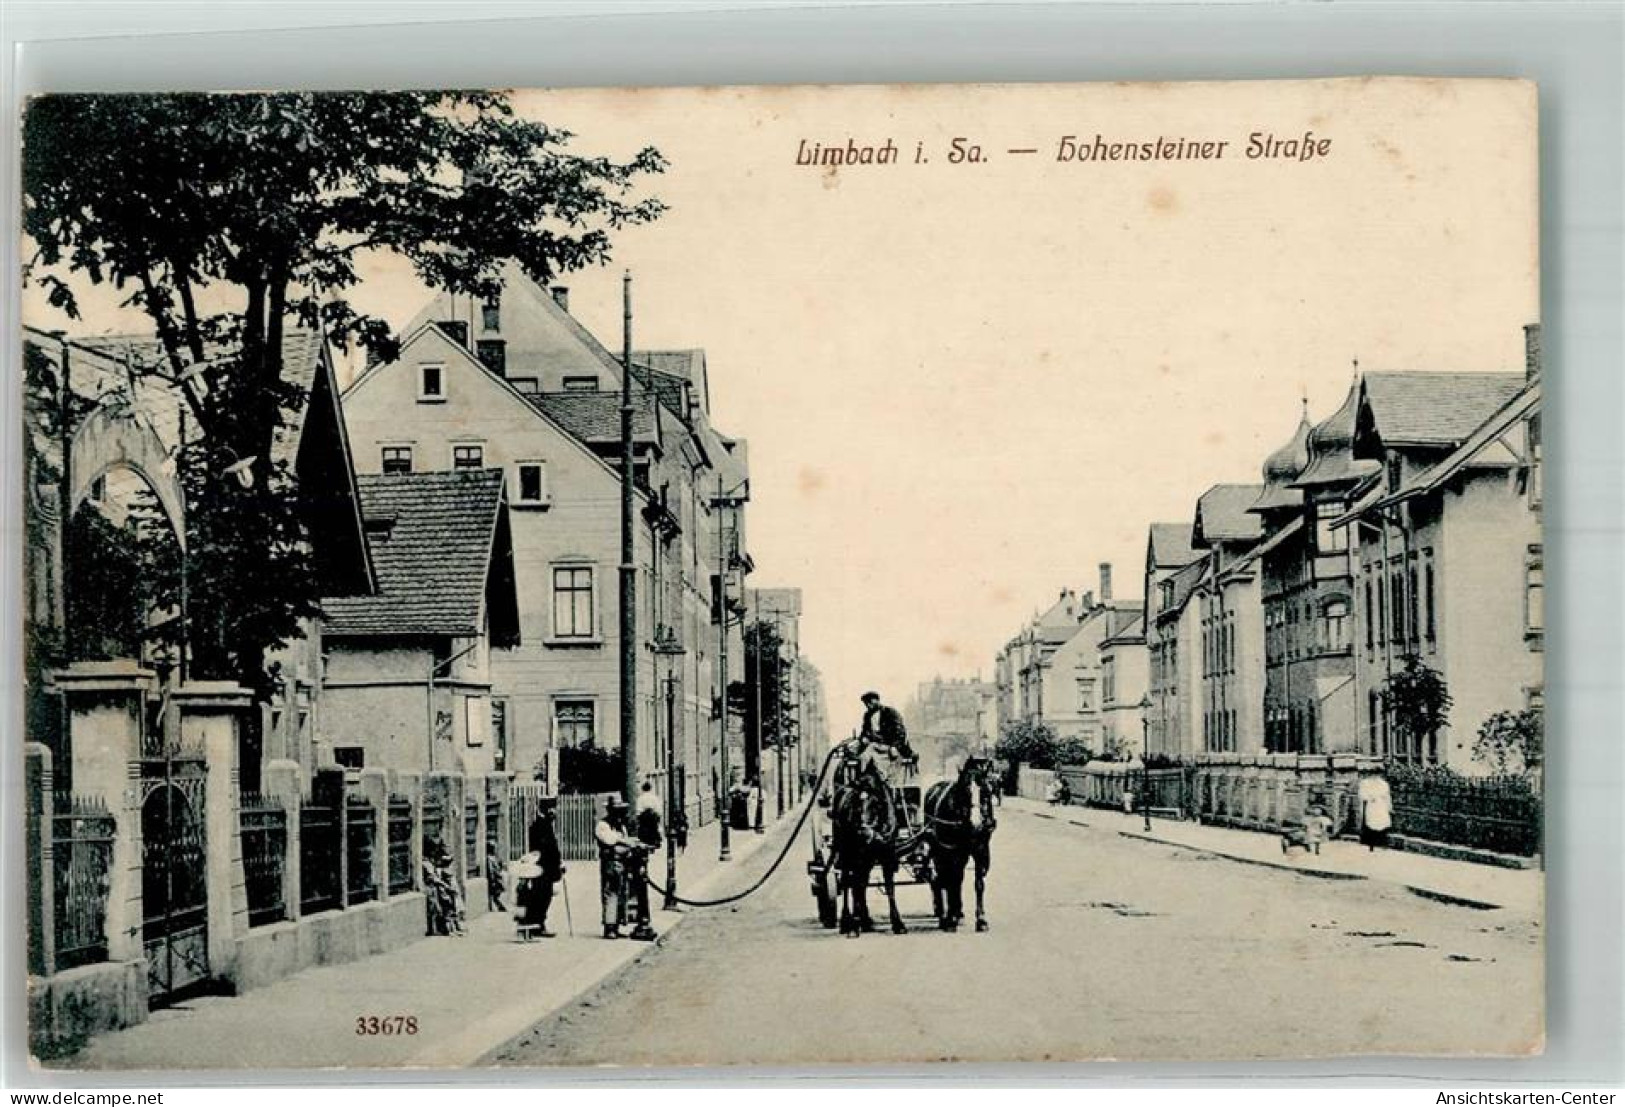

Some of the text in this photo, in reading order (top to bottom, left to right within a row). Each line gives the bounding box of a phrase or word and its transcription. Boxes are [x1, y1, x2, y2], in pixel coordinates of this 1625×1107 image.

[795, 138, 898, 166] Limbach
[914, 141, 928, 164] i.
[947, 137, 988, 164] Sa.
[1056, 134, 1229, 162] Hohensteiner
[1245, 131, 1332, 162] Straße
[355, 1015, 418, 1036] 33678
